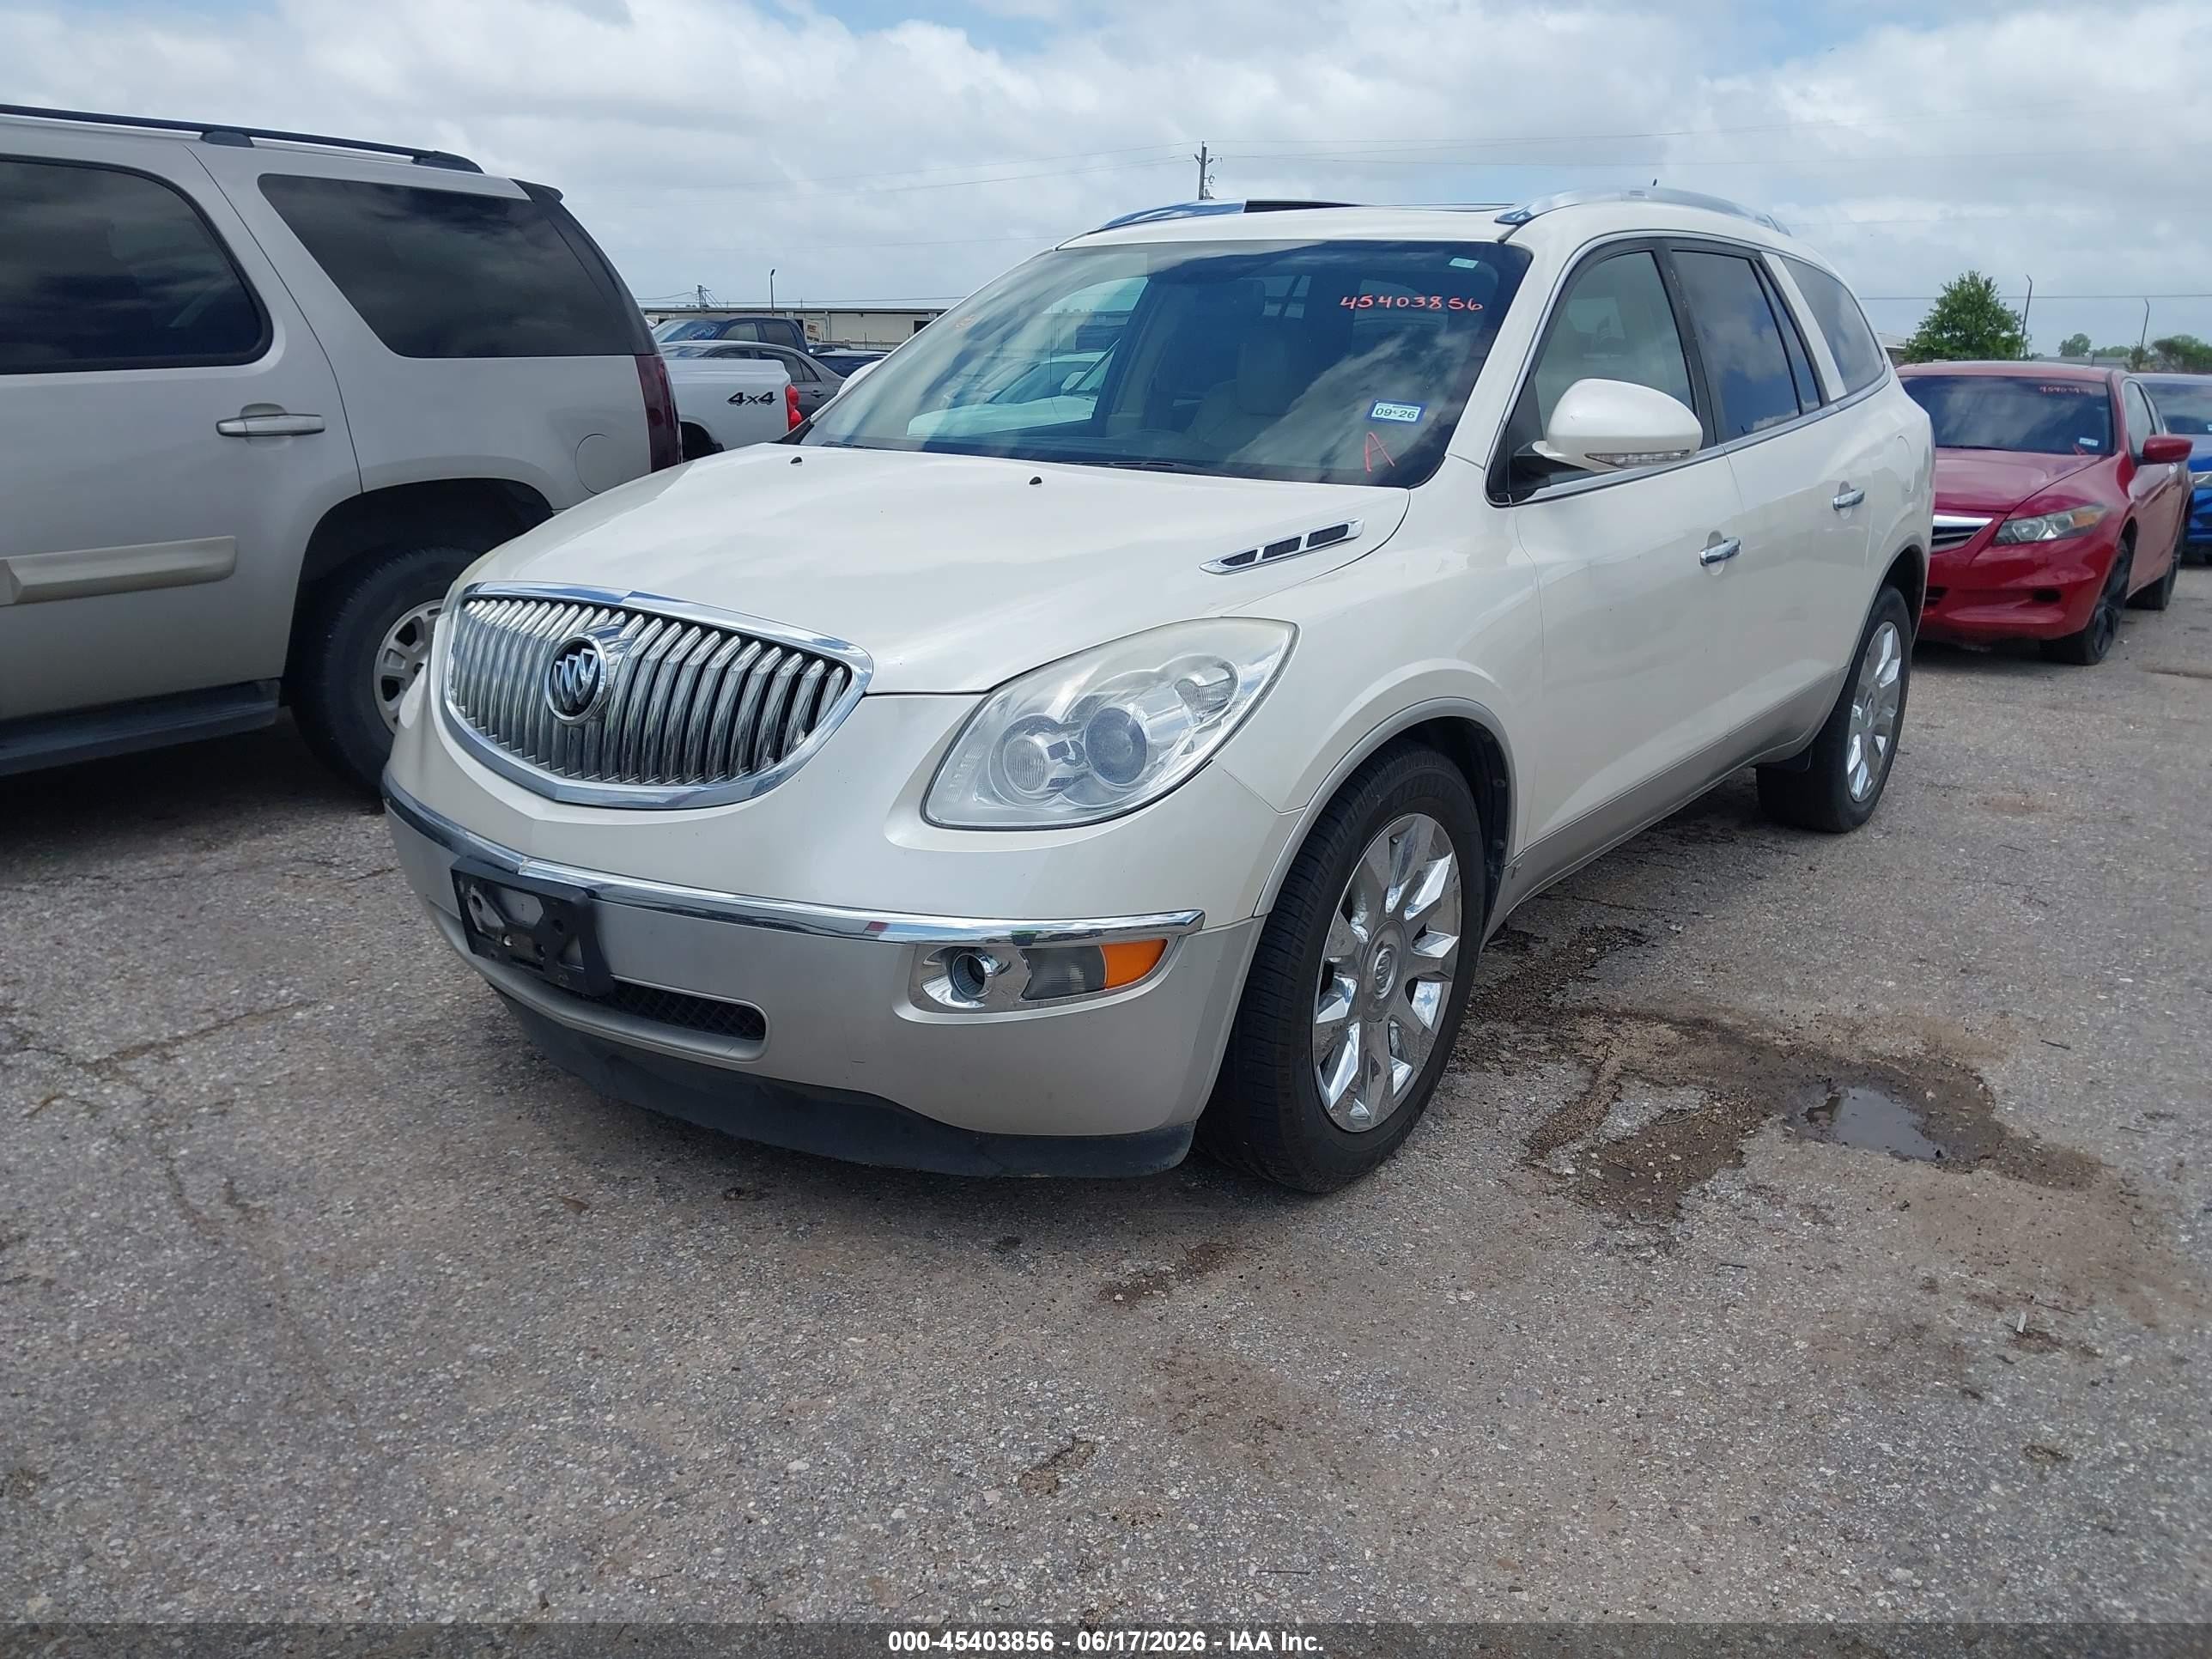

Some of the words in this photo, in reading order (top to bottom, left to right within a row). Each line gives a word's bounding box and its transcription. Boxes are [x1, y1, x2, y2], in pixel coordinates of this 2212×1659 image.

[1340, 295, 1484, 311] 45403856
[726, 392, 777, 406] 4x4
[1375, 407, 1393, 417] 09
[1398, 410, 1417, 420] 26
[1364, 432, 1395, 472] A
